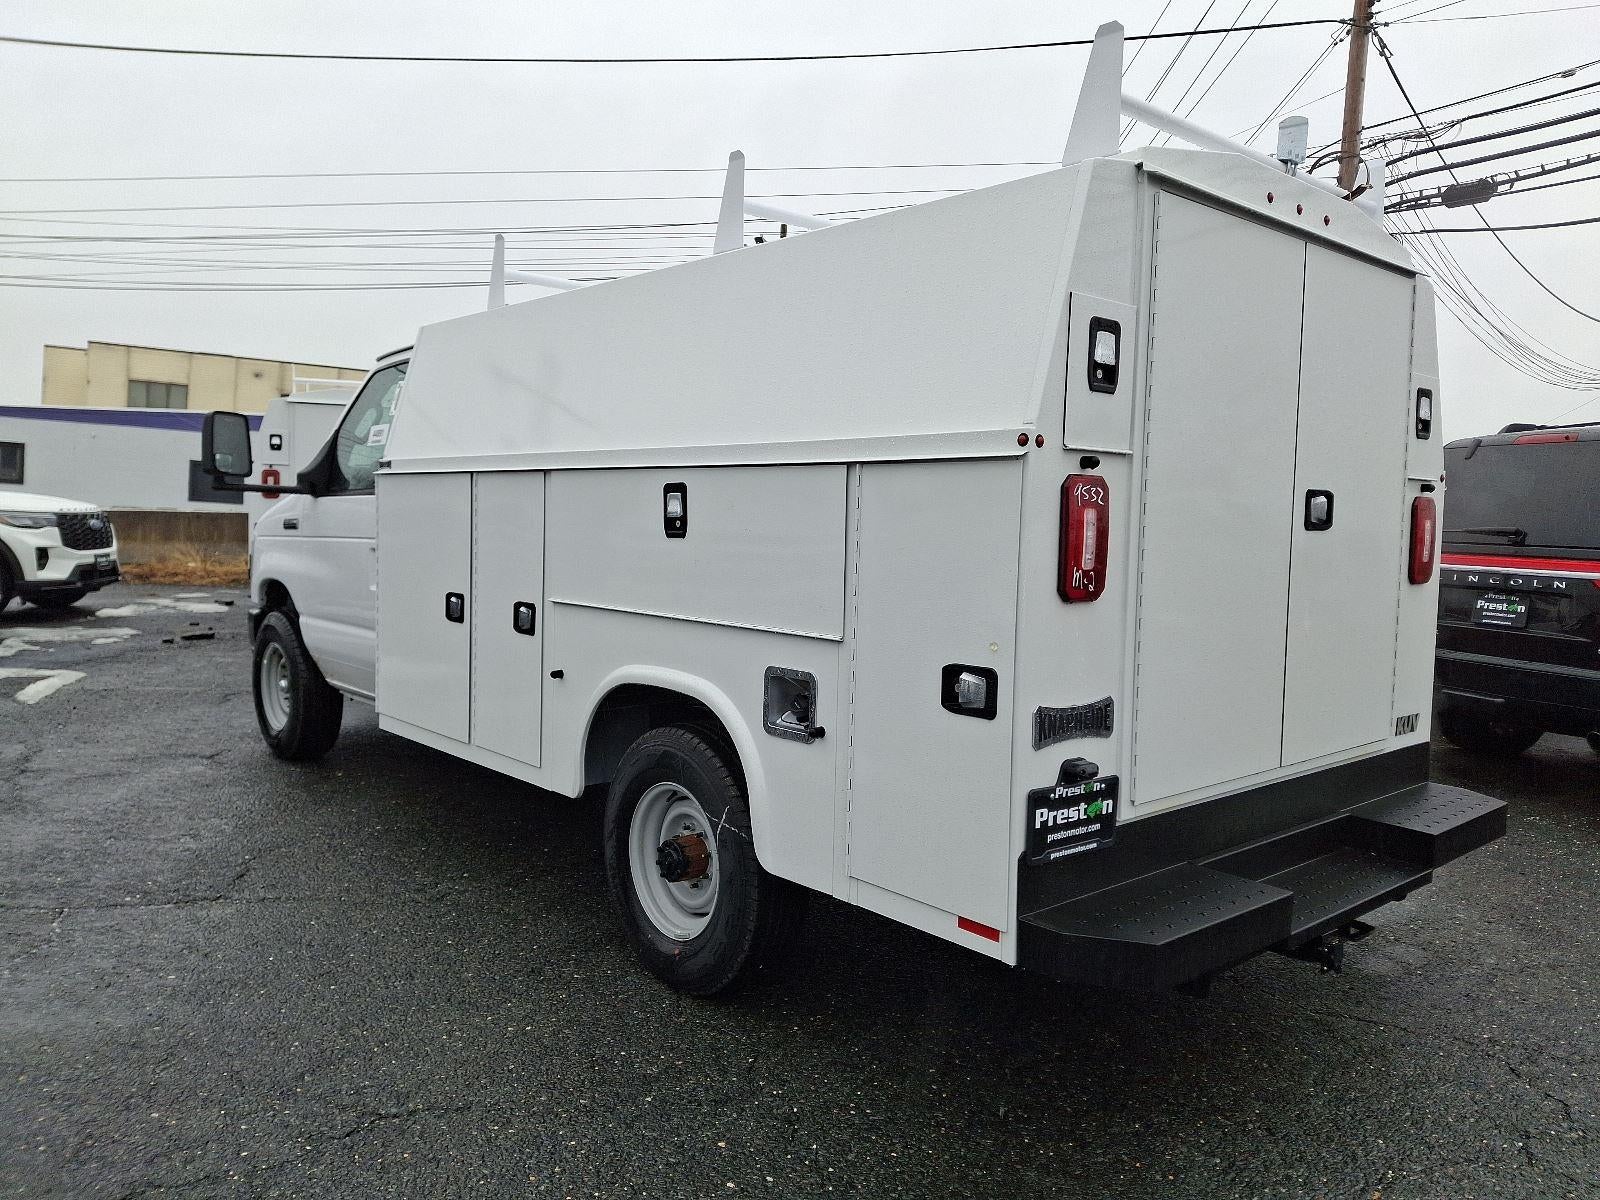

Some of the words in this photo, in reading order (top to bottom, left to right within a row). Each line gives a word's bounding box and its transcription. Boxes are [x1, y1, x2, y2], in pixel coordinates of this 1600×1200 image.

[1440, 574, 1566, 589] INCOLN
[1476, 600, 1526, 613] Preston
[1055, 781, 1101, 799] Preston
[1035, 798, 1114, 829] Preston
[1047, 823, 1101, 843] prestonmotor.com
[1050, 843, 1098, 860] prestonmotor.com
